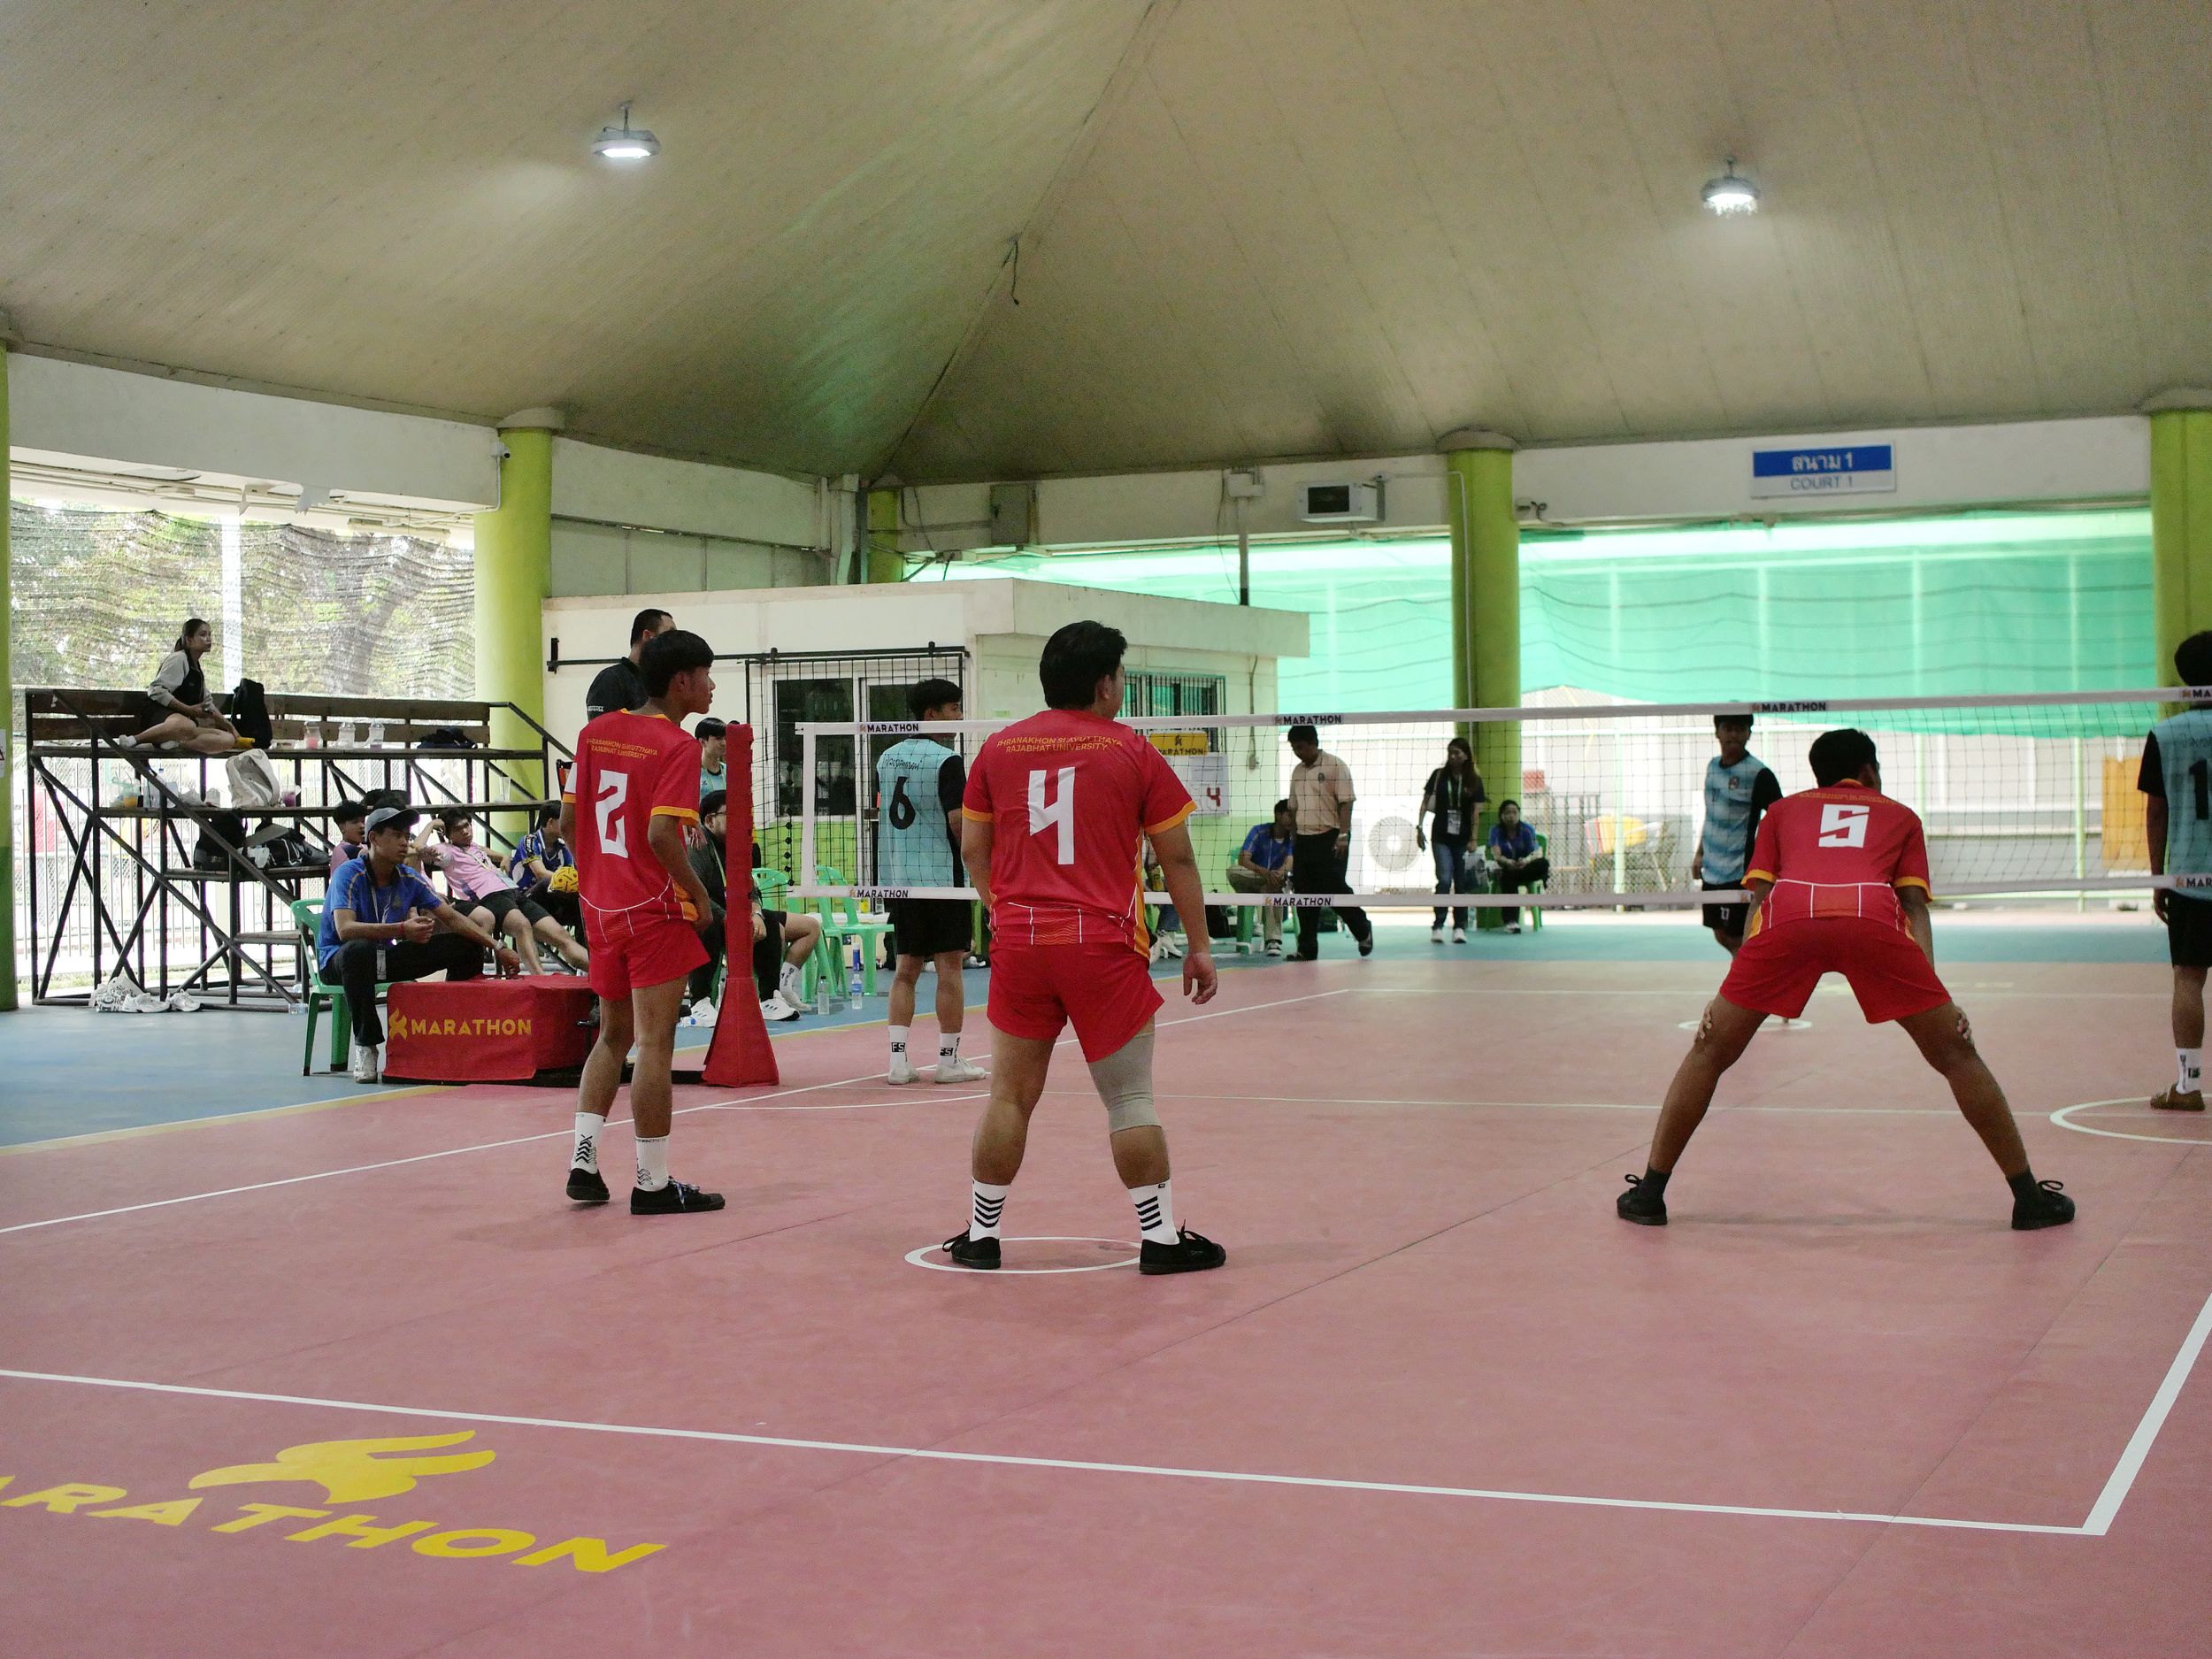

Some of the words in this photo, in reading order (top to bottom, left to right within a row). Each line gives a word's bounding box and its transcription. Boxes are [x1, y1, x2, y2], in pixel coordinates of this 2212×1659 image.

[1792, 455, 1840, 471] สนาม
[1845, 451, 1853, 468] 1
[1791, 477, 1840, 489] COURT
[1847, 475, 1853, 487] 1
[1761, 702, 1826, 712] MARATHON
[1283, 715, 1341, 725] MARATHON
[867, 723, 919, 733] MARATHON
[997, 736, 1056, 748] PHRANAKHON
[1006, 744, 1050, 753] RAJABHAT
[1052, 742, 1109, 751] UNIVERSITY
[889, 776, 916, 830] 6
[1206, 787, 1221, 807] 4
[595, 769, 629, 859] 2
[1027, 766, 1076, 864] 4
[1818, 803, 1870, 849] 5
[1274, 897, 1332, 906] MARATHON
[411, 1018, 532, 1035] MARATHON
[892, 1042, 905, 1052] FS
[0, 1475, 669, 1573] RATHON
